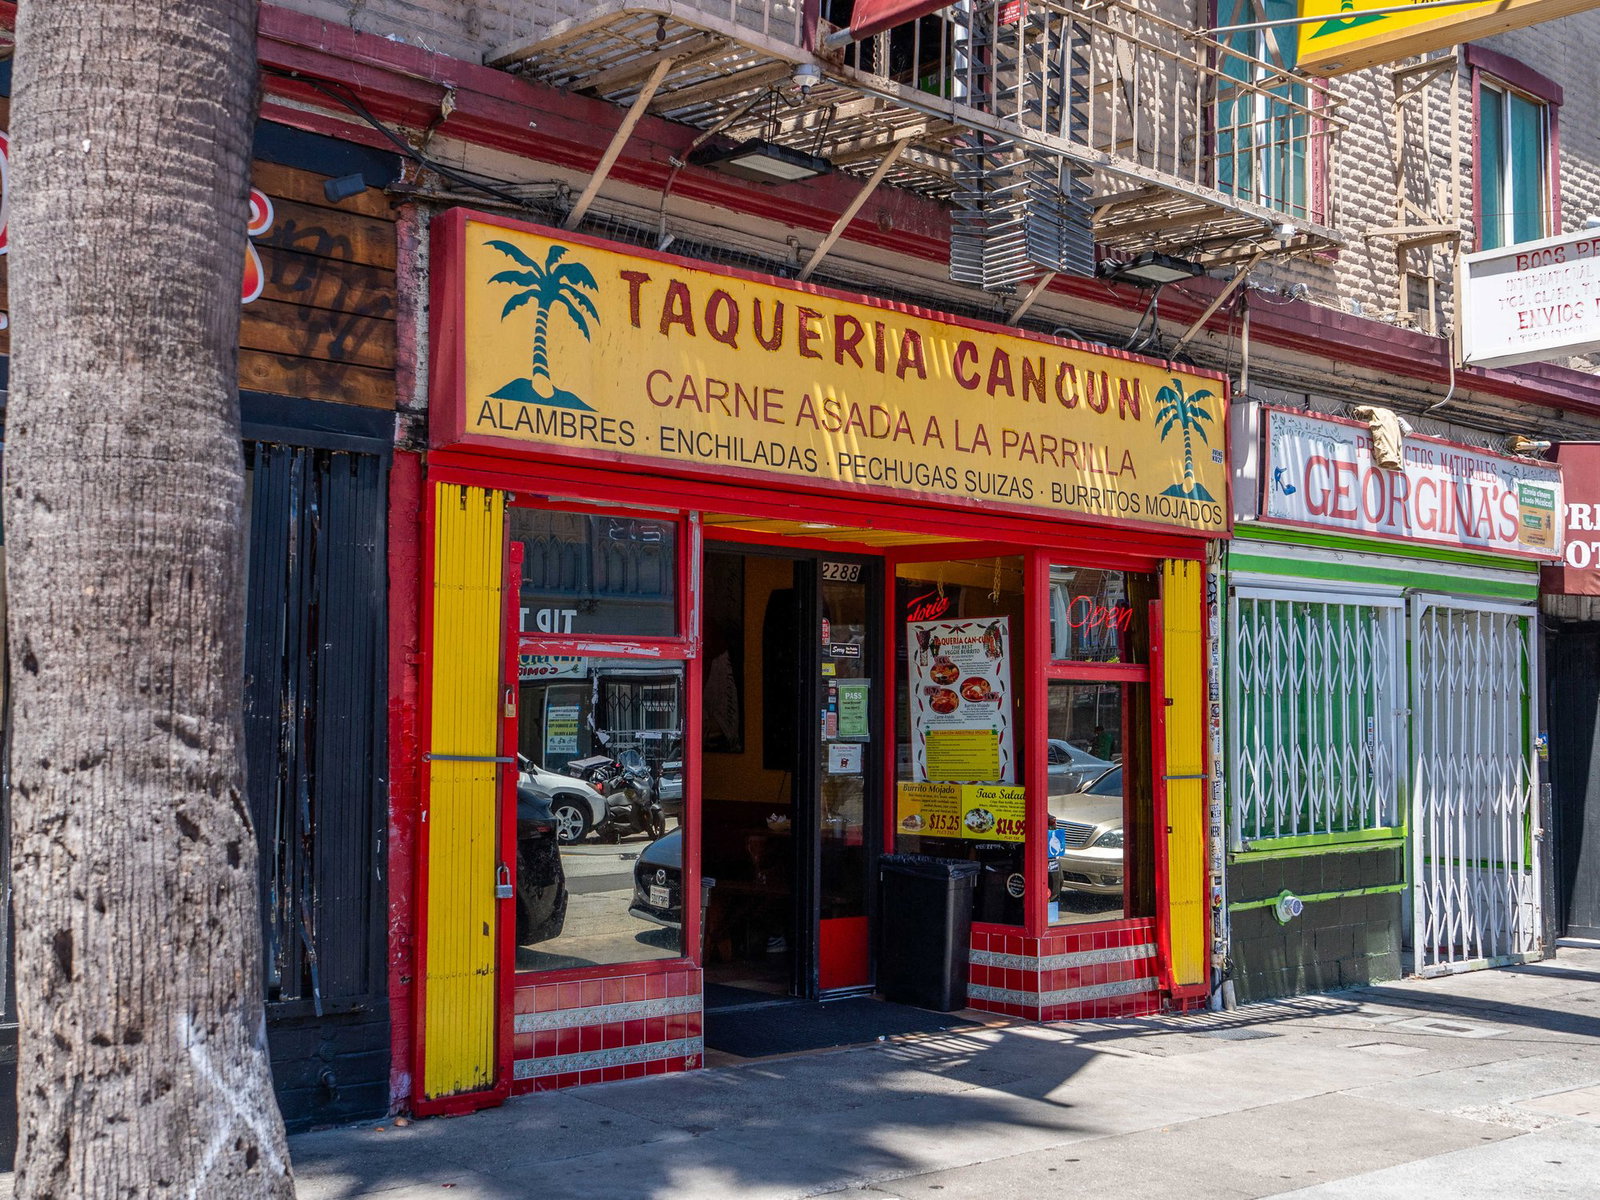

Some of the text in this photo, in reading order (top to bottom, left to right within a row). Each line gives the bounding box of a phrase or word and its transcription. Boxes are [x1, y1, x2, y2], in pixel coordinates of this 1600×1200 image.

[620, 269, 1141, 421] TAQUERIA CANCUN
[646, 369, 1137, 480] CARNE ASADA A LA PARRILLA
[477, 400, 1222, 525] ALAMBRES ENCHILADAS PECHUGAS SUIZAS BURRITOS MOJADOS
[1356, 435, 1497, 483] PRCTOS NATURALES
[1304, 455, 1519, 543] GEORGINA'S
[822, 563, 859, 580] 2288
[1067, 595, 1133, 638] Open
[832, 645, 845, 655] Sorry
[844, 692, 862, 700] PASS
[903, 784, 955, 795] Burrito Mojado
[975, 788, 997, 799] Taco
[928, 813, 960, 831] $15.25
